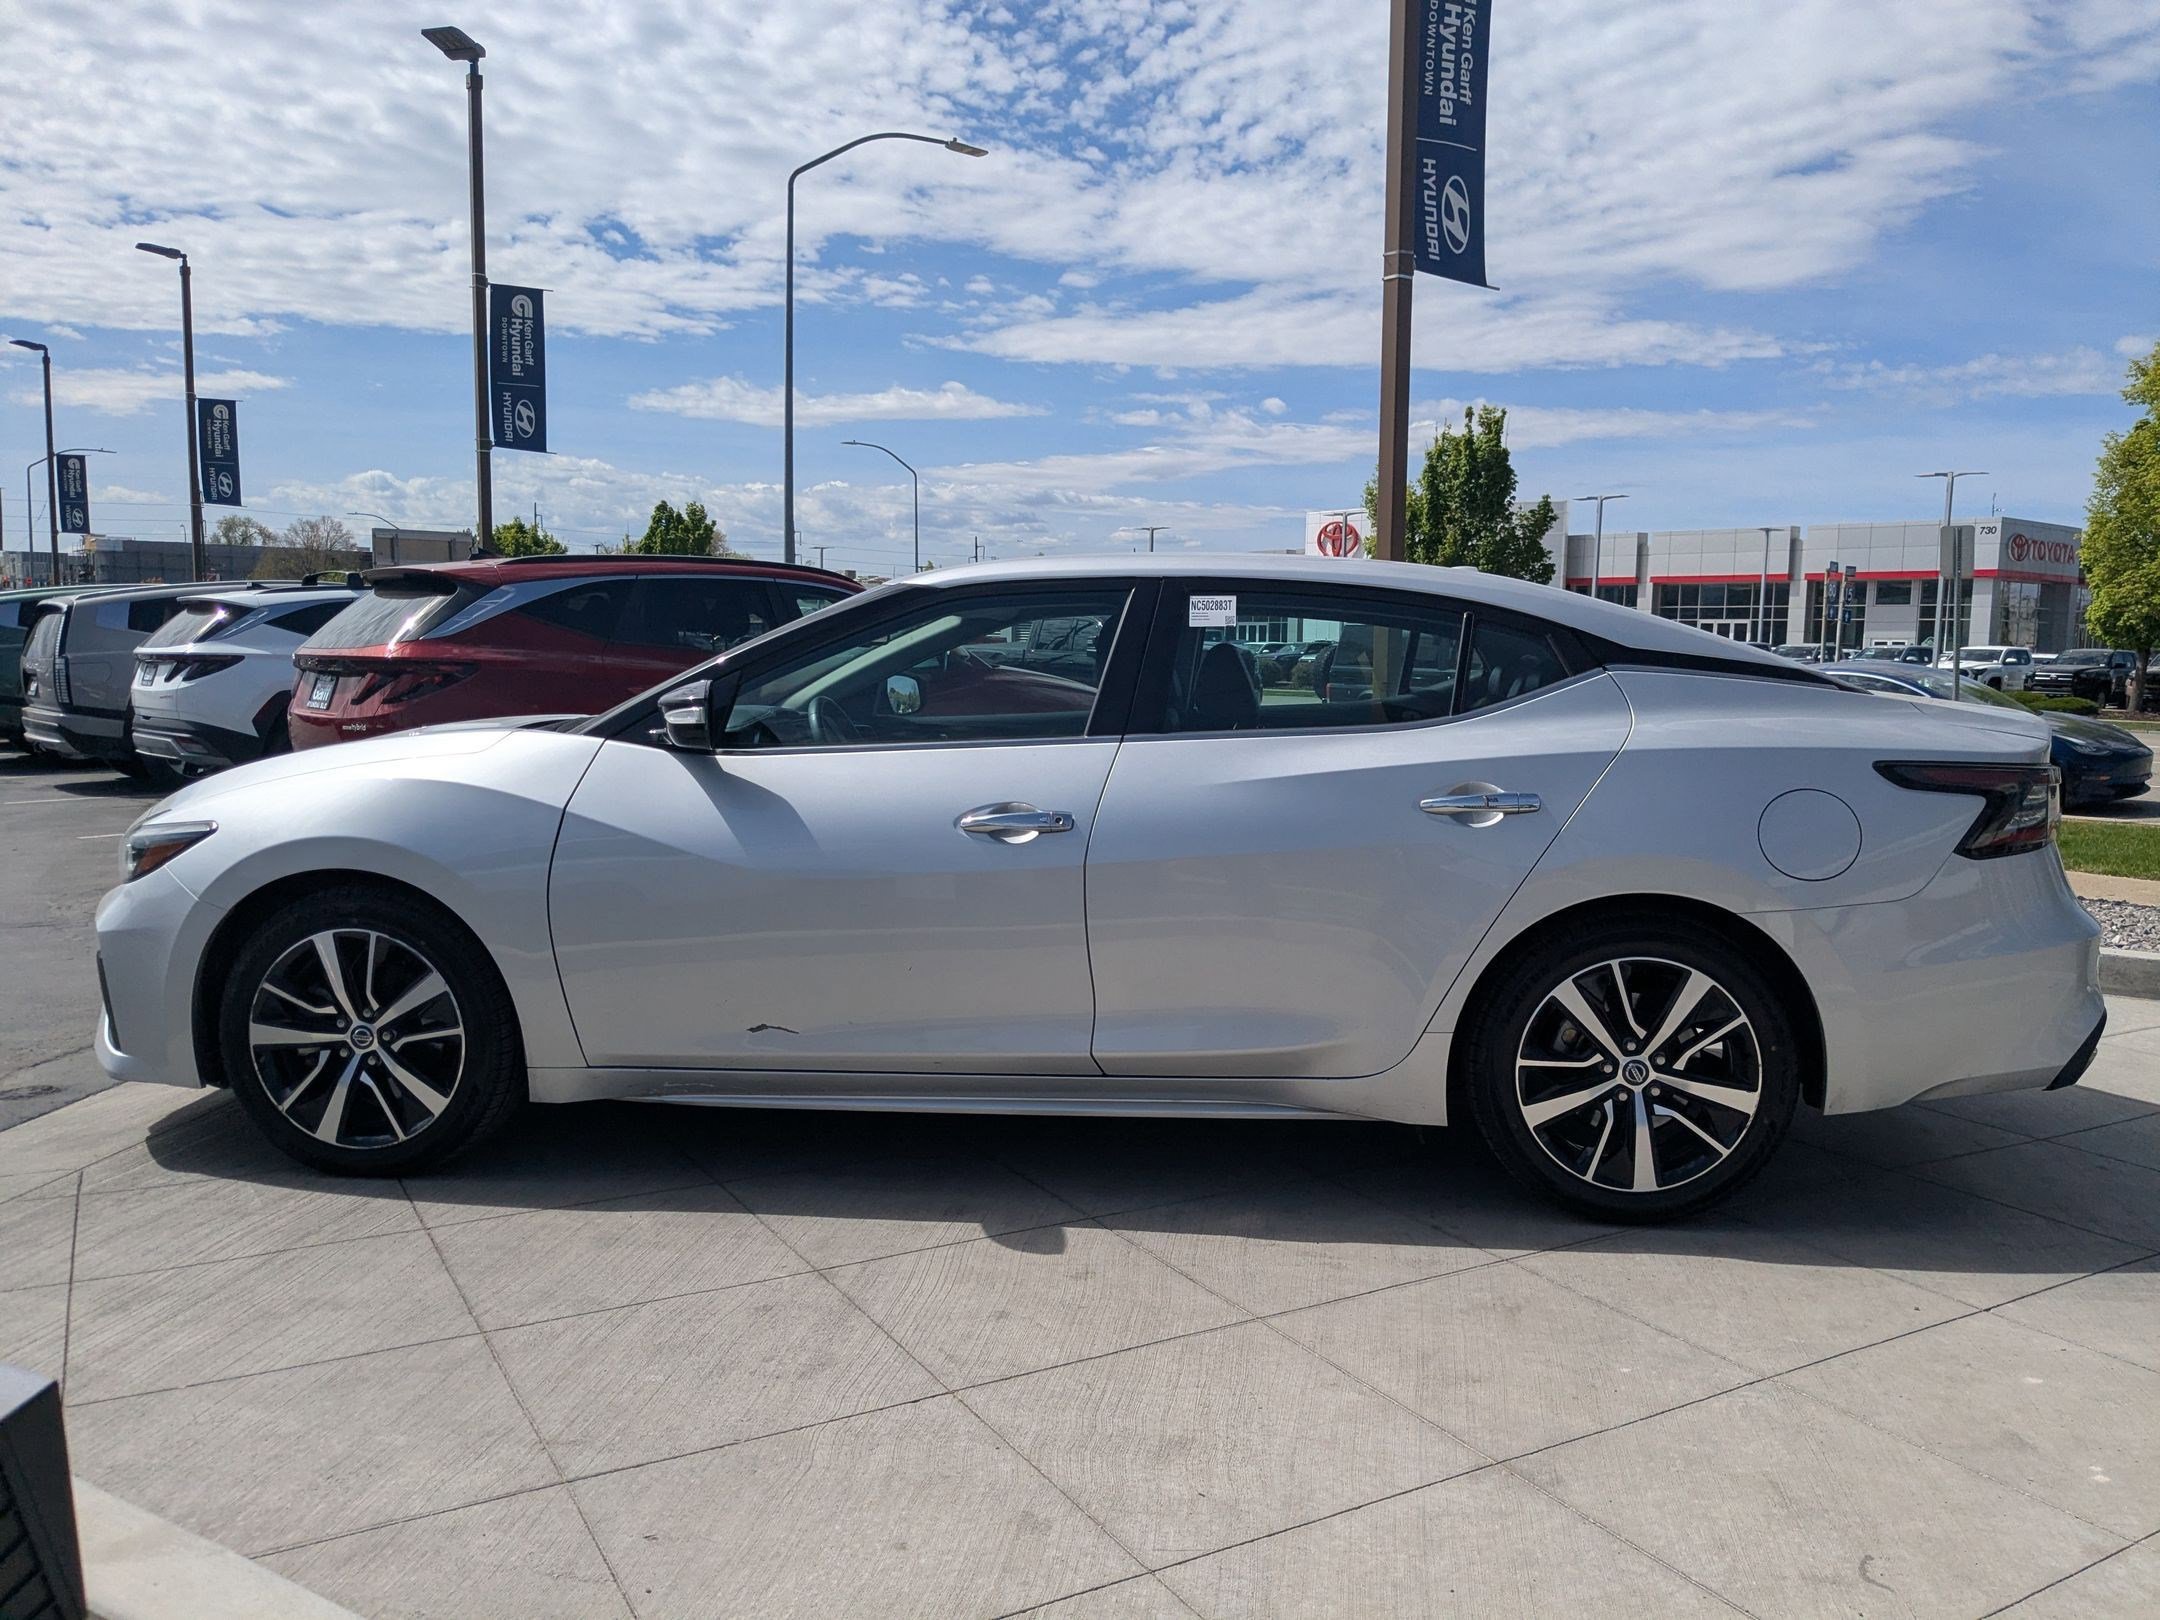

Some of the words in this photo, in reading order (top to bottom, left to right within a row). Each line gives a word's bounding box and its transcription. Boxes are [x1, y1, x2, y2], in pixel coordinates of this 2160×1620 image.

[1424, 0, 1438, 96] DOWNTOWN
[1463, 7, 1476, 49] Ken
[1439, 3, 1462, 126] Hyundai
[1459, 52, 1474, 106] Garff
[1423, 158, 1441, 262] HYUNDAI
[509, 318, 524, 376] Hyundai
[524, 320, 533, 338] Ken
[525, 338, 534, 366] Garff
[212, 419, 224, 458] Hyundai
[503, 392, 513, 442] HYUNDAI
[1979, 526, 1997, 535] 730
[2030, 540, 2075, 564] TOYOTA
